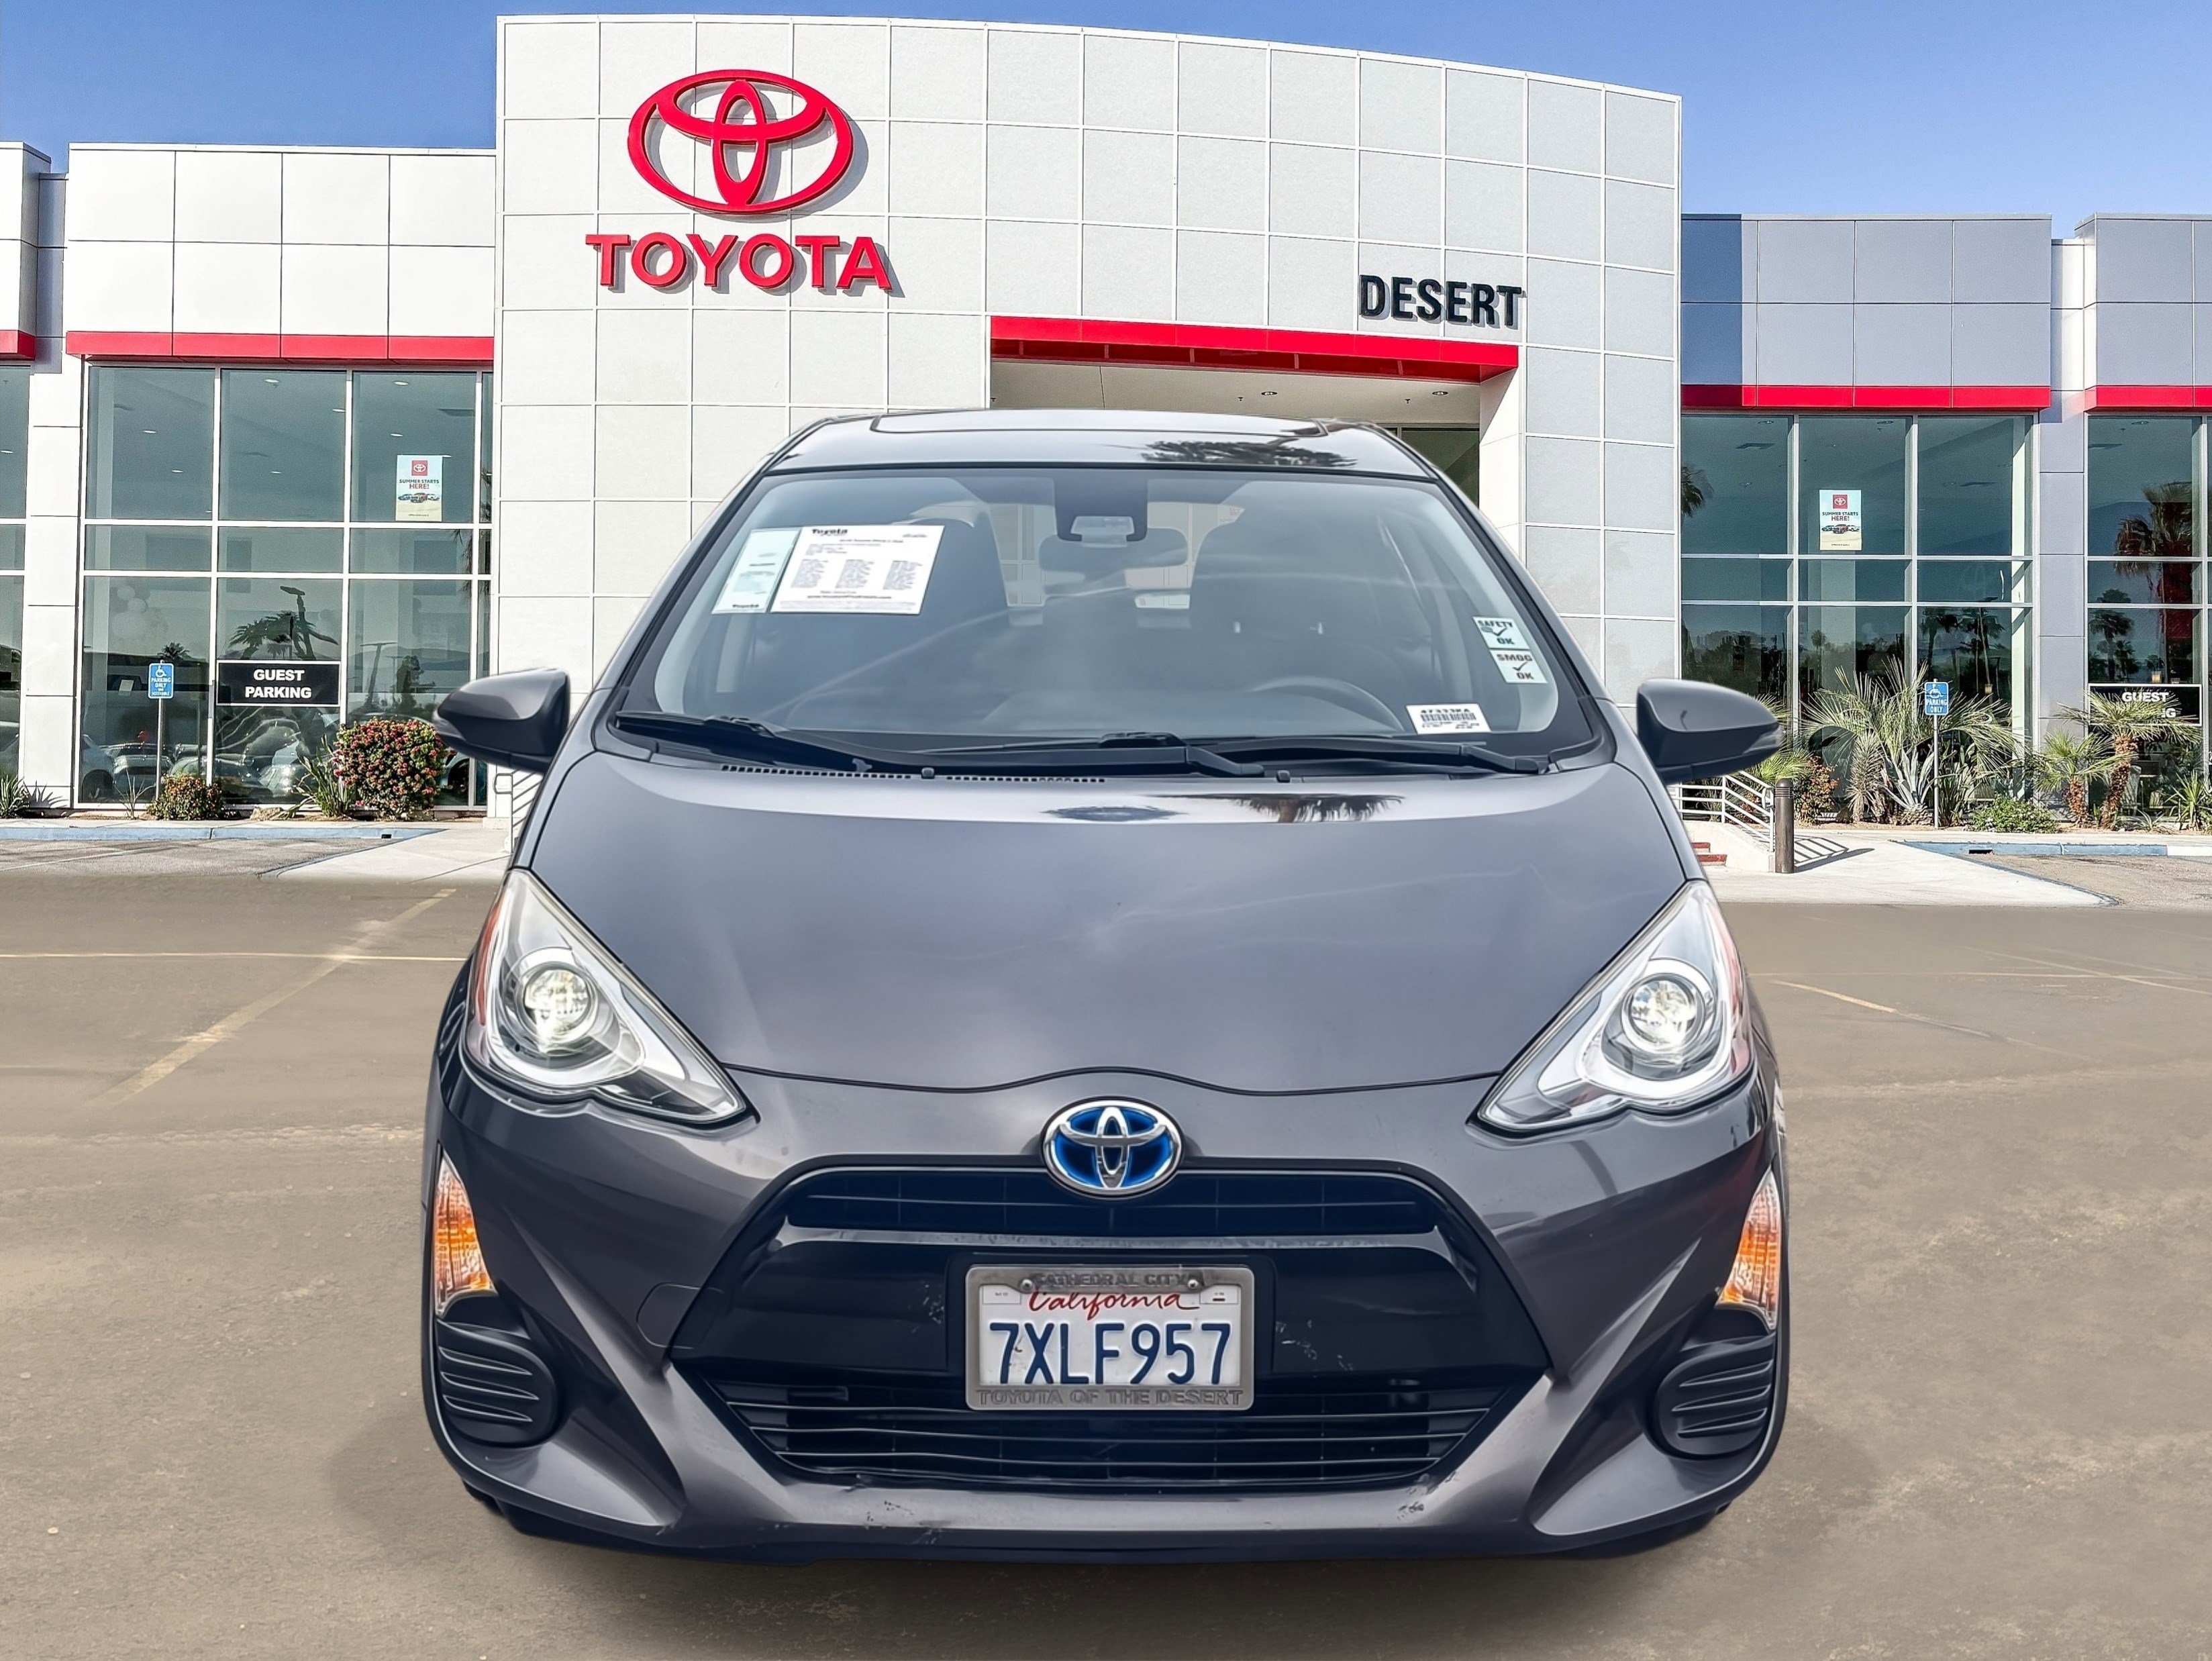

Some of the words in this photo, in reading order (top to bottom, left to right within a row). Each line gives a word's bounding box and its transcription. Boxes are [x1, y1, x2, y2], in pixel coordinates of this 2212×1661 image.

[585, 232, 891, 290] TOYOTA
[1359, 274, 1522, 327] DESERT
[1497, 654, 1533, 662] SMOG
[254, 669, 305, 681] GUEST
[245, 686, 312, 699] PARKING
[2121, 692, 2170, 703] GUEST
[1037, 1274, 1138, 1285] CATHEDRAL
[1144, 1274, 1188, 1285] CITY
[1029, 1291, 1200, 1320] California
[990, 1323, 1231, 1385] 7XLF957
[976, 1389, 1063, 1405] TOYOTA
[1070, 1389, 1101, 1405] OF
[1106, 1389, 1150, 1405] THE
[1156, 1389, 1244, 1405] DESERT
